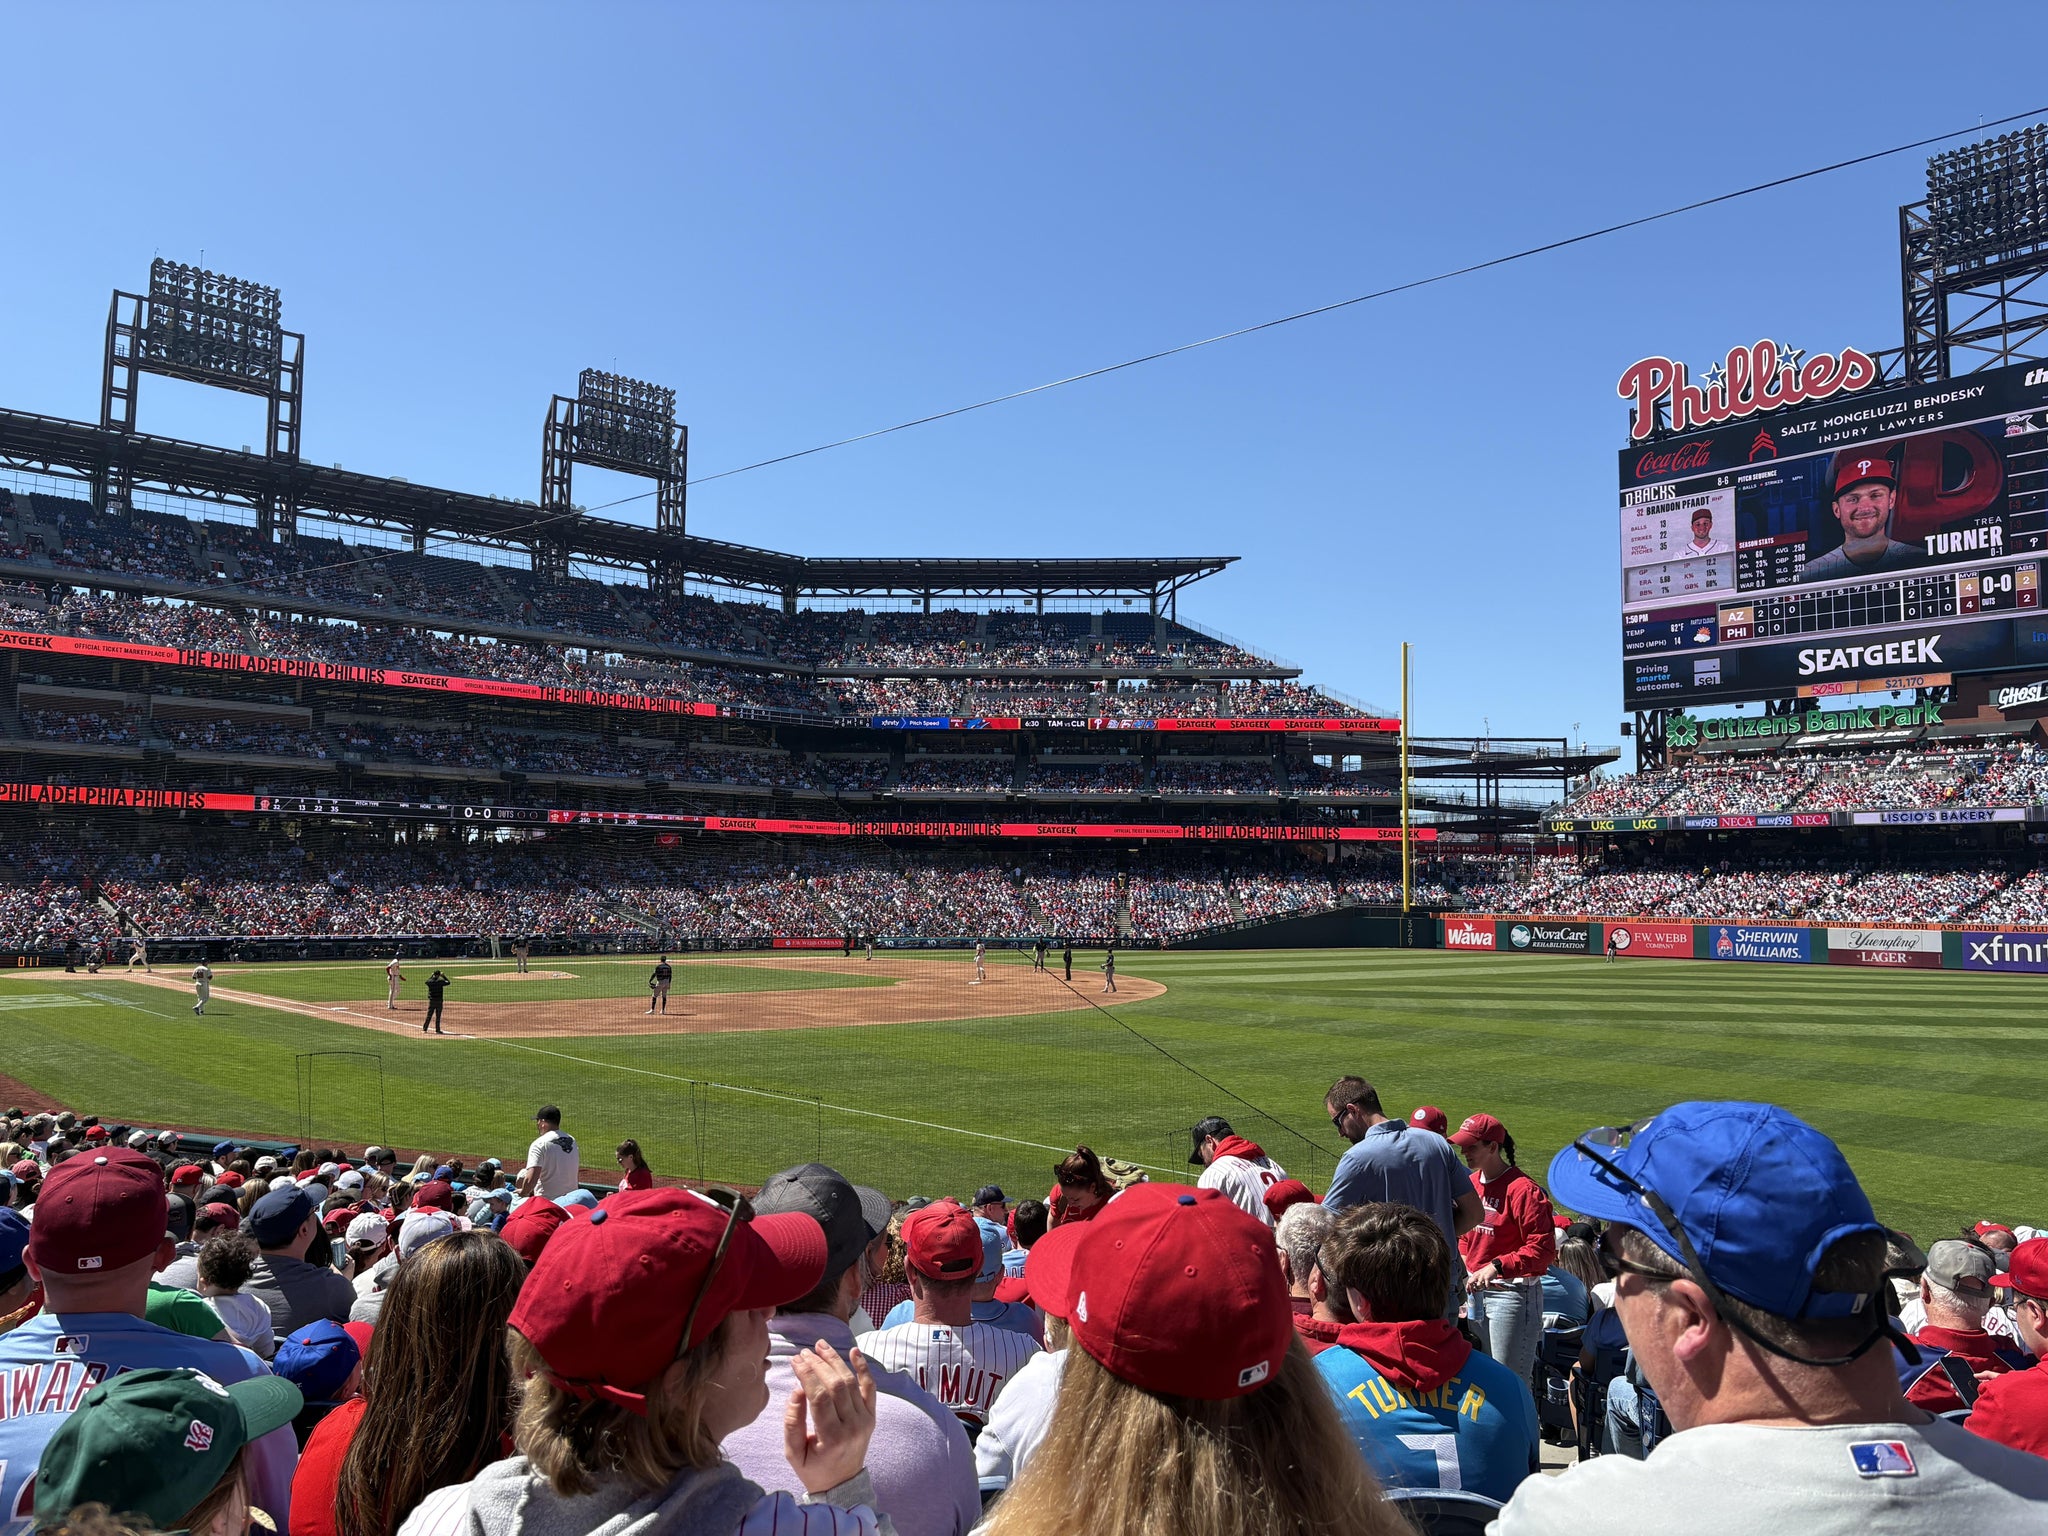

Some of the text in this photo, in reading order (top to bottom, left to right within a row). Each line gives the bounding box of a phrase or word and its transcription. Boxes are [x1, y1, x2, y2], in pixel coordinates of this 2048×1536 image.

[1617, 338, 1875, 439] Phillies
[1781, 386, 1985, 437] SALTZ MONGELUZZI BENDESKY
[1818, 411, 1945, 443] INJURY LAWYERS
[1636, 439, 1714, 478] Coca-Cola
[1717, 476, 1728, 486] 8-6
[1646, 501, 1680, 515] BRANDON
[1682, 496, 1710, 509] PFAADT
[1660, 520, 1666, 528] 13
[1975, 516, 2002, 526] TREA
[1660, 531, 1667, 539] 22
[1660, 542, 1667, 550] 35
[1925, 526, 2002, 556] TURNER
[1728, 574, 2031, 622] AZ 2 0 0 2 3 1 4 0-0 2
[1625, 614, 1649, 624] 1:50 PM
[1727, 594, 2031, 638] PHI 0 0 0 1 0 4 OUTS 2
[1626, 629, 1645, 637] TEMP
[1646, 640, 1667, 648] (MPH)
[1674, 637, 1681, 646] 14
[75, 643, 100, 651] OFFICIAL
[124, 647, 165, 657] MARKETPLACE
[1798, 634, 1943, 676] SEATGEEK
[177, 649, 385, 685] THE PHILADELPHIA PHILLIES
[1636, 665, 1669, 675] Driving
[401, 673, 449, 688] SEATGEEK
[1636, 673, 1671, 683] smarter
[1886, 677, 1924, 688] $21,170
[1636, 682, 1683, 692] outcomes.
[539, 686, 695, 714] THE PHILADELPHIA PHILLIES
[1176, 720, 1216, 729] SEATGEEK
[1230, 720, 1270, 729] SEATGEEK
[1284, 720, 1325, 729] SEATGEEK
[1340, 720, 1381, 729] SEATGEEK
[1702, 716, 1801, 739] Citizens
[1806, 705, 1874, 732] Bank
[1879, 701, 1943, 726] Park
[0, 784, 205, 809] PHILADELPHIA PHILLIES
[498, 810, 514, 818] OUTS
[1880, 809, 1996, 823] LISCIO'S BAKERY
[719, 820, 757, 829] SEATGEEK
[1590, 820, 1615, 831] UKG
[1632, 819, 1657, 830] UKG
[1722, 817, 1754, 827] NECA
[1796, 815, 1829, 825] NECA
[850, 823, 1001, 836] THE PHILADELPHIA PHILLIES
[1037, 825, 1077, 835] SEATGEEK
[1551, 821, 1574, 832] UKG
[1181, 826, 1340, 840] THE PHILADELPHIA PHILLIES
[1377, 829, 1420, 839] SEATGEK
[1690, 918, 1738, 926] ASPLUNDH
[1808, 921, 1861, 929] ASPLUNDH
[1872, 922, 1929, 930] ASPLUNDH
[1532, 926, 1587, 941] NovaCare
[1940, 924, 2000, 932] ASPLUNDH
[1448, 928, 1492, 946] Wawa
[1654, 934, 1687, 942] WEBB
[1735, 929, 1798, 944] SHERWIN
[1848, 930, 1920, 950] Yuengling
[1735, 943, 1802, 959] WILLIAMS
[1861, 951, 1908, 963] LAGER
[1396, 1434, 1461, 1490] 7
